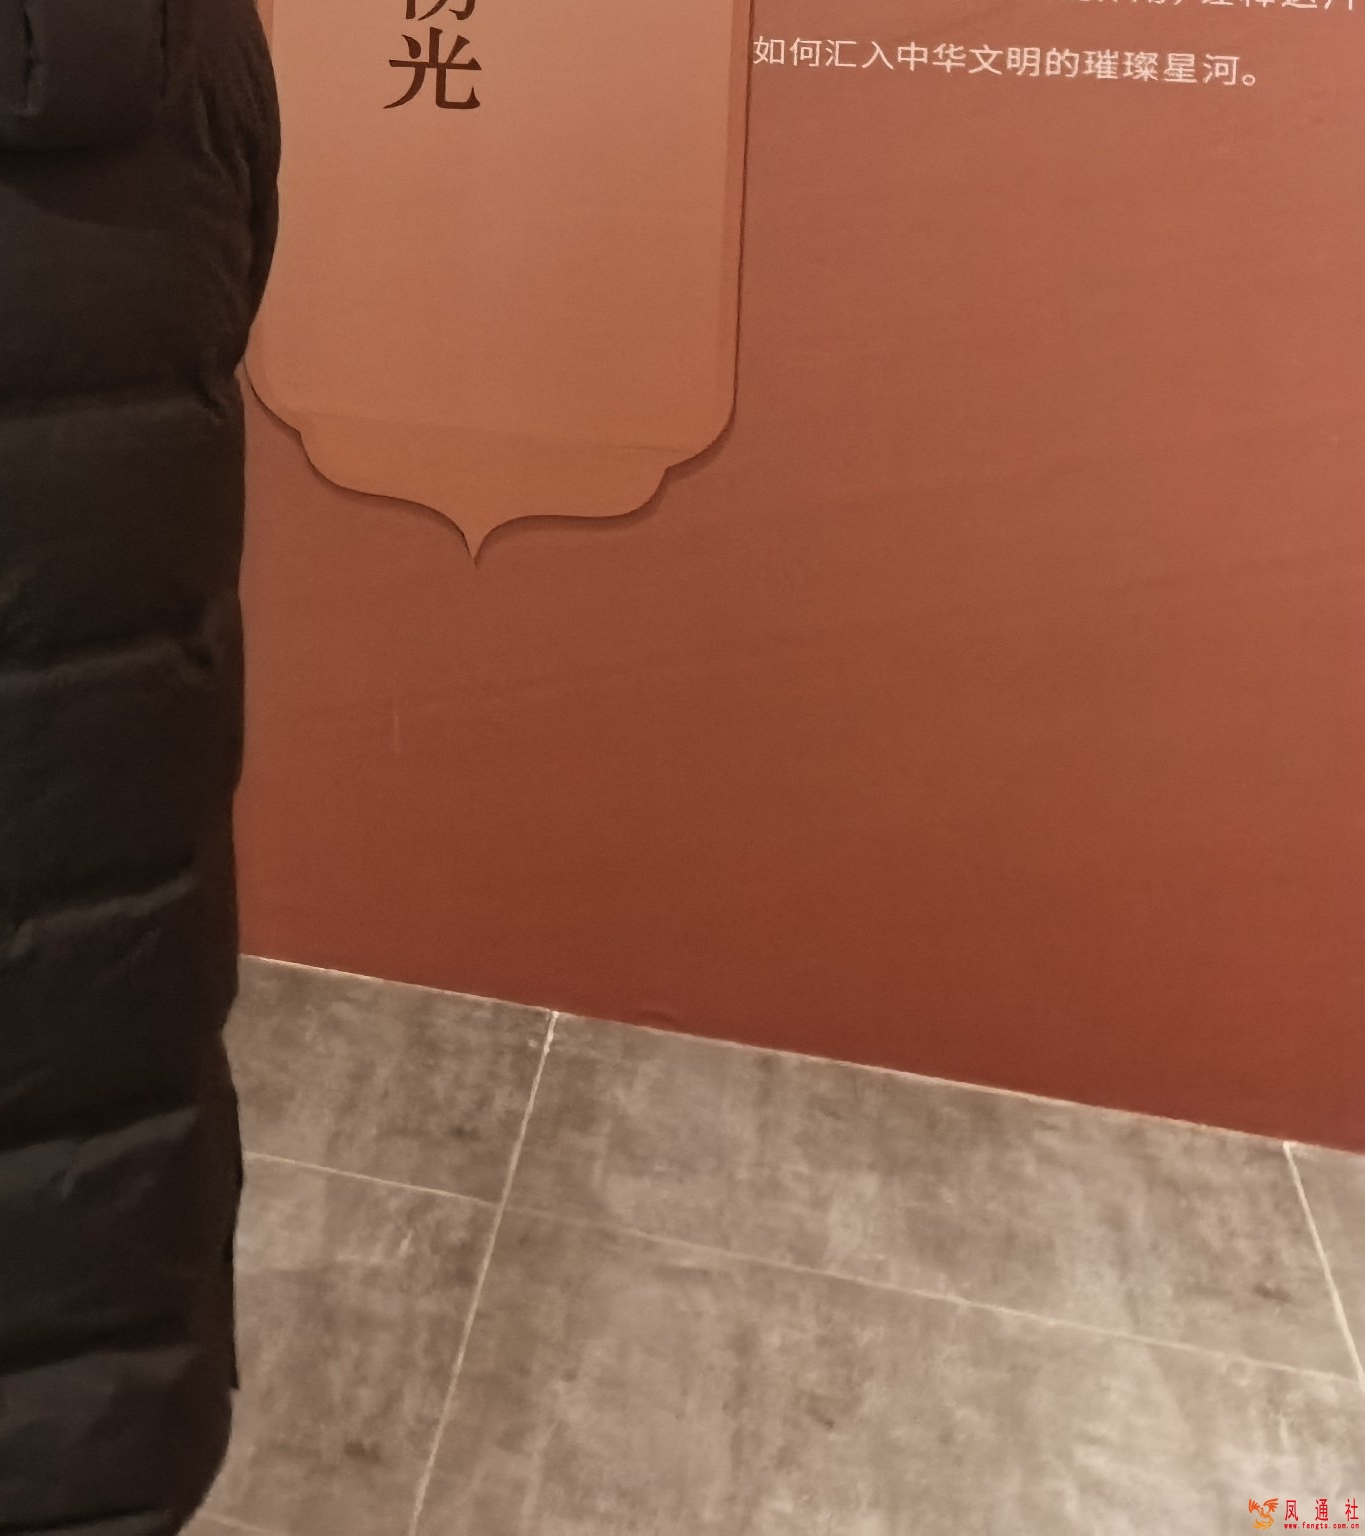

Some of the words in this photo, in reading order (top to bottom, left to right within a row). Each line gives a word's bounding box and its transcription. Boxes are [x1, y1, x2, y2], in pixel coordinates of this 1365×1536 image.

[753, 36, 1256, 87] 如何汇入中华文明的璀璨星河。
